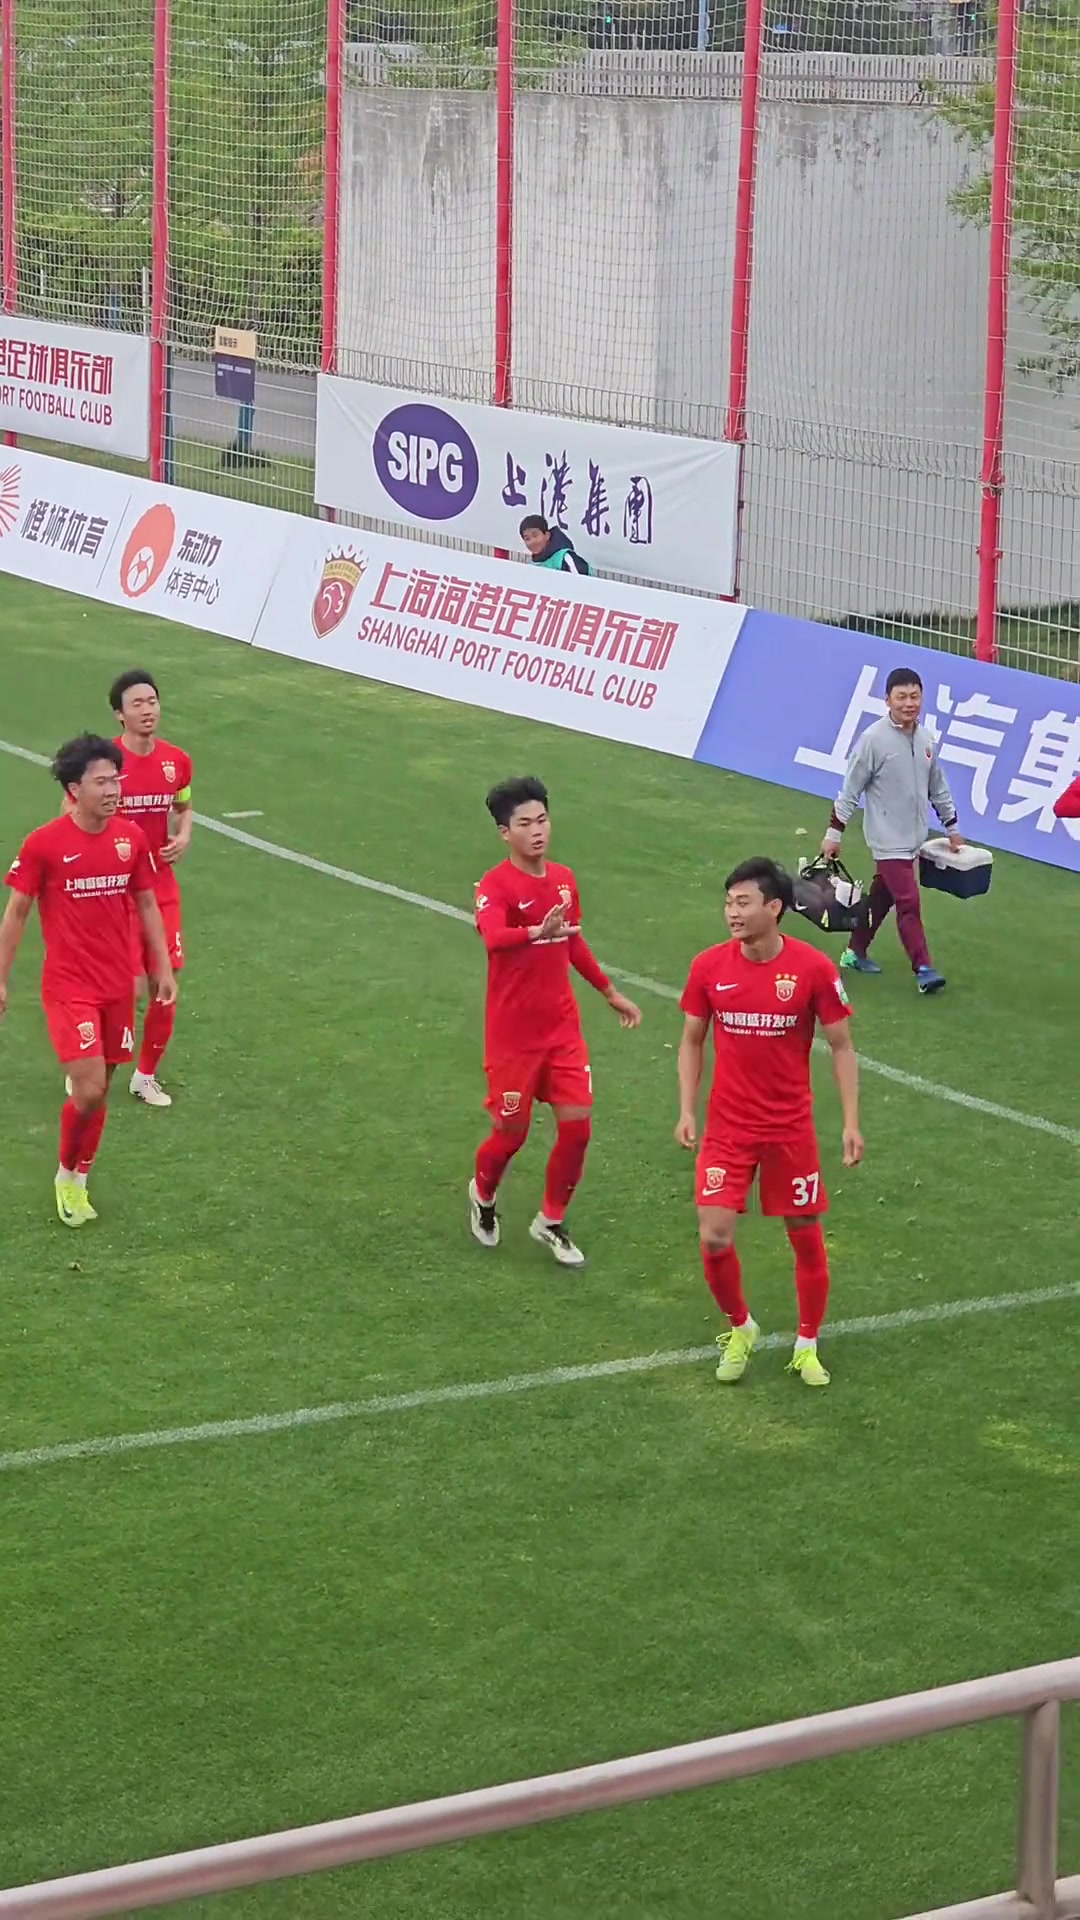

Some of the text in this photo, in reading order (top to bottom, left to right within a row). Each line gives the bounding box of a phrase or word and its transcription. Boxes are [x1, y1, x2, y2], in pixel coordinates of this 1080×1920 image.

[0, 385, 113, 426] RT FOOTBALL CLUB
[386, 430, 463, 494] SIPG
[19, 498, 110, 560] 橙狮体育
[176, 528, 223, 568] 乐动力
[164, 566, 221, 606] 体育中心
[368, 560, 680, 672] 上海海港足球俱乐部
[356, 615, 659, 711] SHANGHAI PORT FOOTBALL CLUB
[791, 1171, 819, 1207] 37
